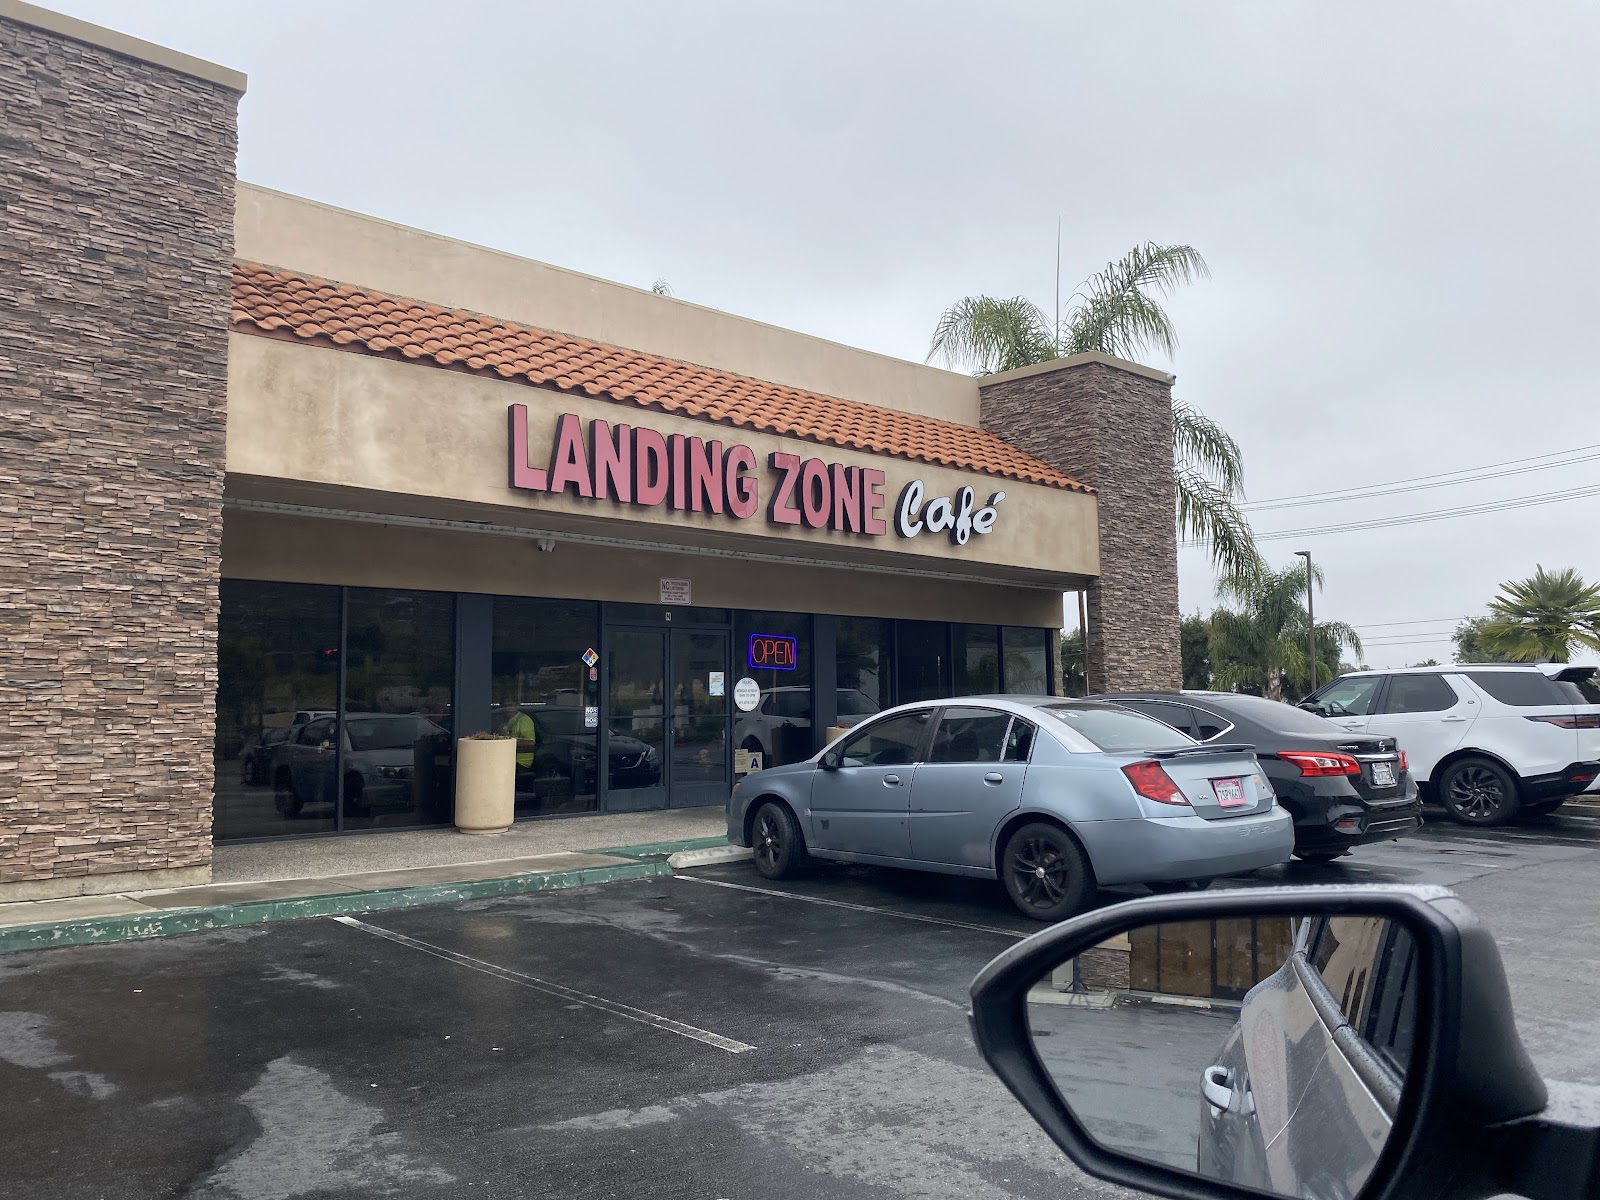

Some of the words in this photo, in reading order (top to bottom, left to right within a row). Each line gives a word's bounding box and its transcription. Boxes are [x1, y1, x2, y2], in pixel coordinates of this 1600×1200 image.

[508, 403, 758, 519] LANDING
[768, 451, 886, 536] ZONE
[894, 479, 1006, 545] Café
[752, 638, 795, 665] OPEN
[750, 757, 760, 769] A
